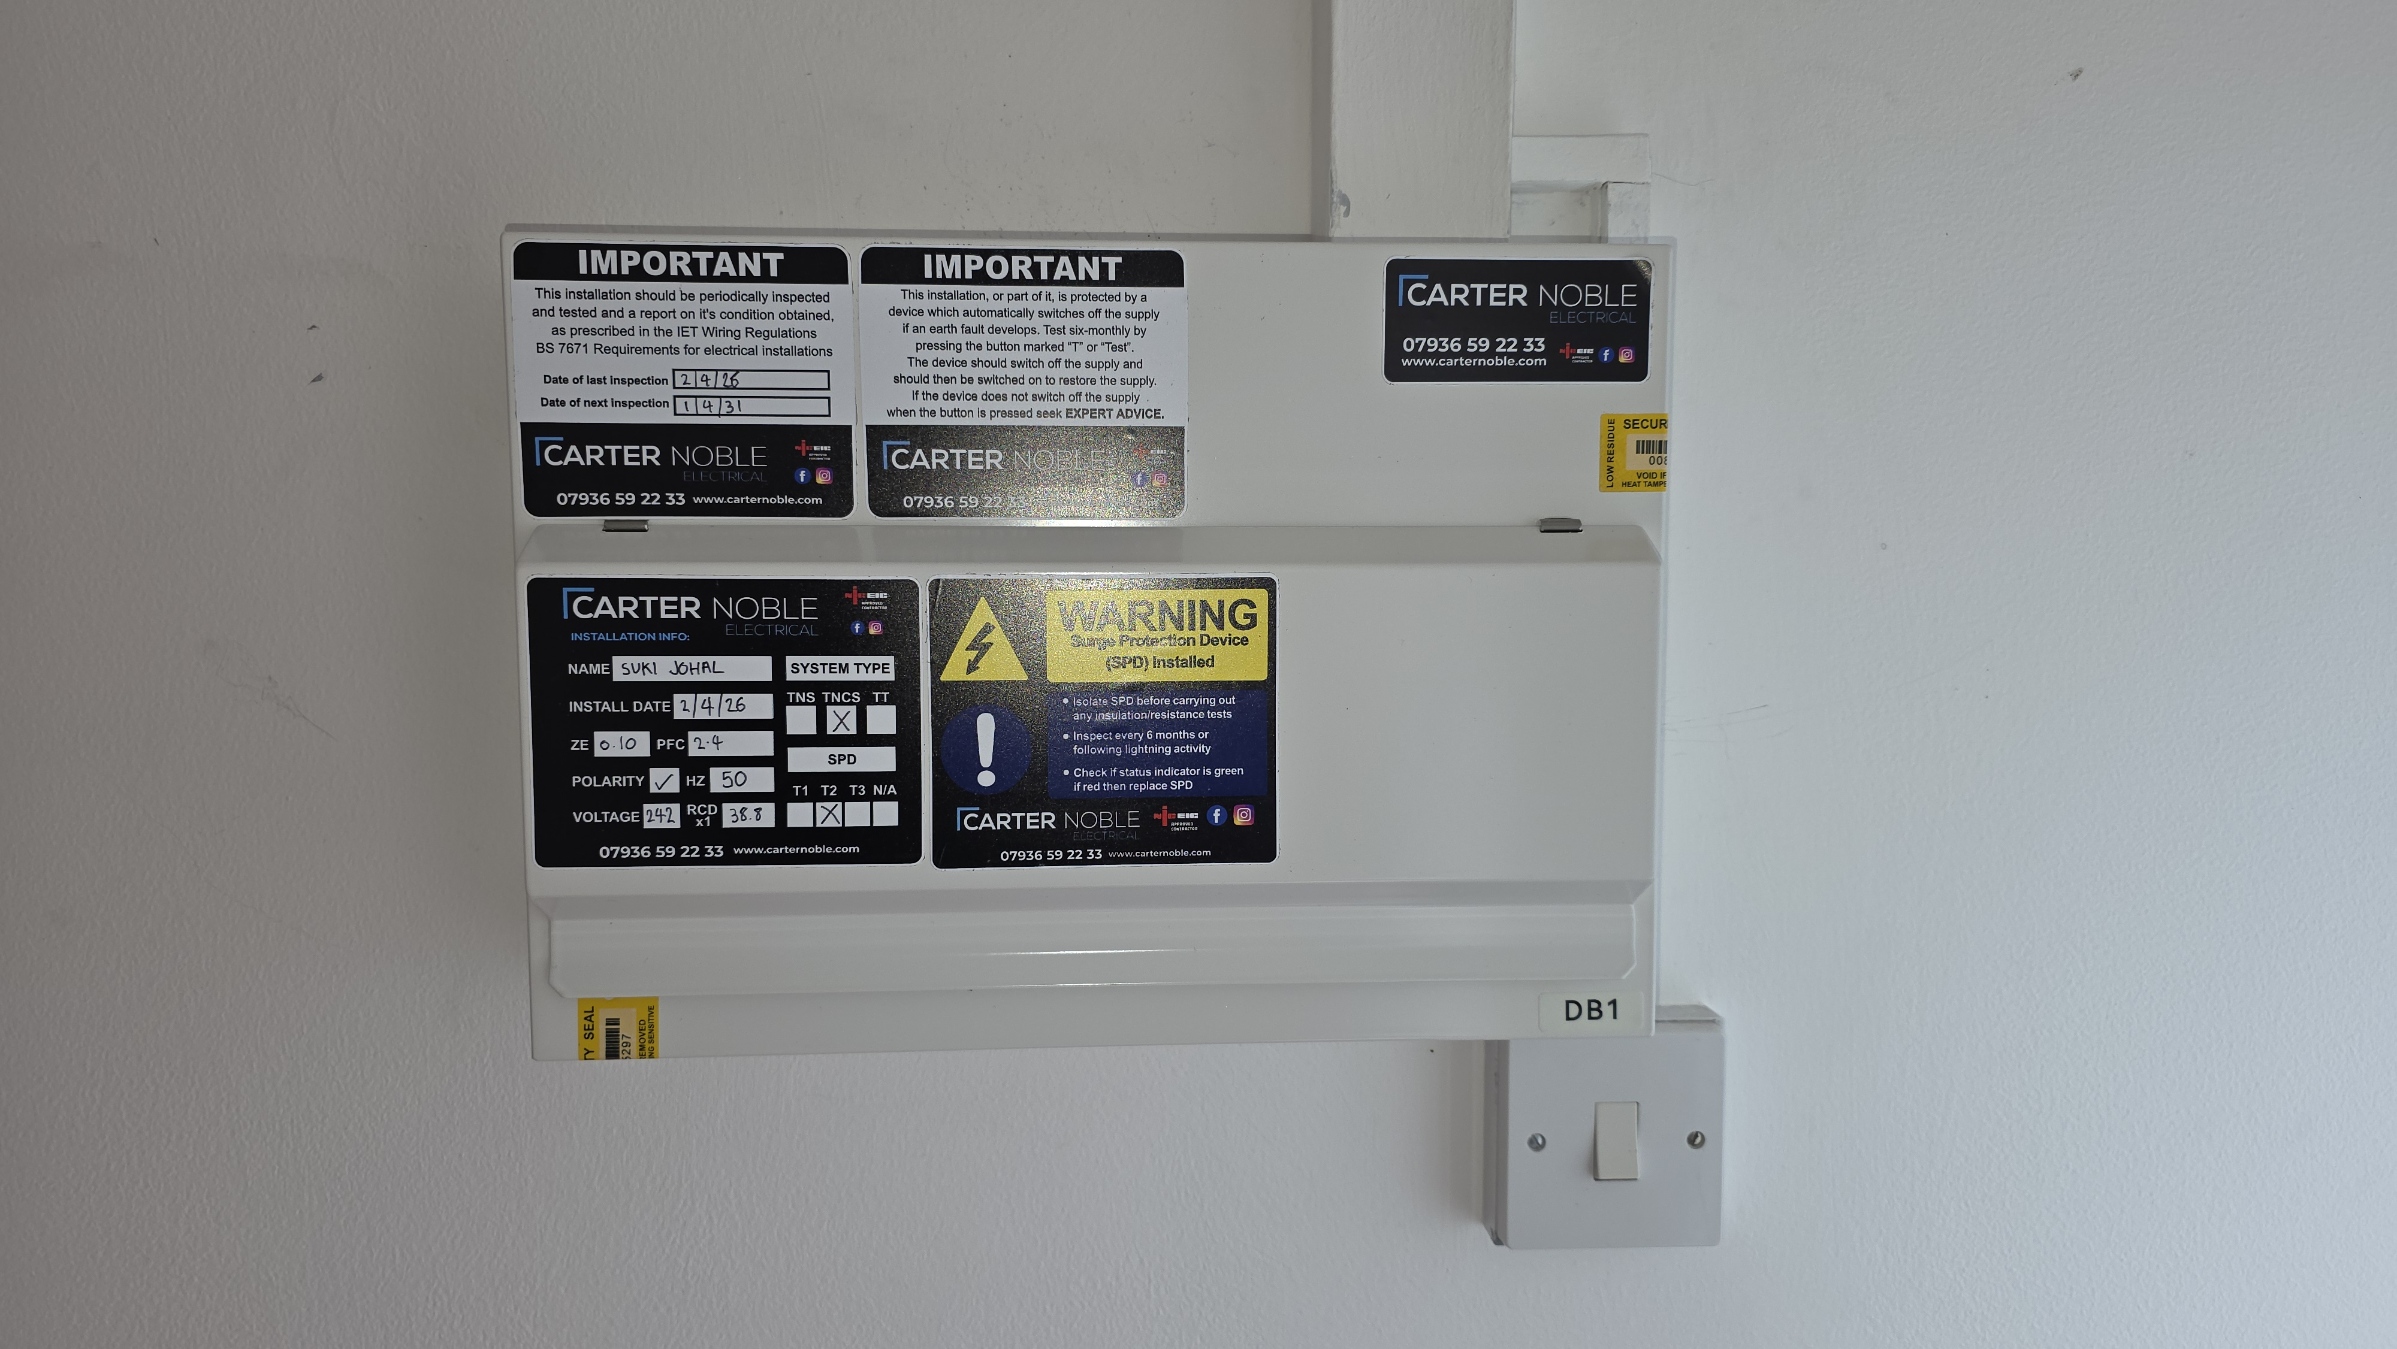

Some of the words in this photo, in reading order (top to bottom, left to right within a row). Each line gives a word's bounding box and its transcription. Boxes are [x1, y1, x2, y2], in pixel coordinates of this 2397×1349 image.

[578, 249, 784, 277] IMPORTANT
[924, 254, 1122, 280] IMPORTANT
[534, 287, 561, 299] This
[565, 287, 631, 300] installation
[635, 289, 675, 301] should
[679, 289, 695, 301] be
[699, 290, 768, 305] periodically
[772, 290, 829, 305] inspected
[900, 288, 924, 300] This
[927, 289, 989, 302] installation,
[992, 292, 1004, 301] or
[1007, 291, 1028, 303] part
[1031, 290, 1043, 301] of
[1045, 290, 1054, 303] it,
[1058, 291, 1067, 302] is
[1070, 291, 1121, 304] protected
[1124, 291, 1137, 304] by
[1140, 294, 1147, 302] a
[1407, 282, 1528, 306] CARTER
[1539, 283, 1637, 307] NOBLE
[888, 306, 924, 316] device
[927, 306, 959, 317] which
[962, 307, 1034, 321] automatically
[1037, 307, 1085, 318] switches
[1087, 308, 1102, 318] off
[1104, 308, 1121, 319] the
[1124, 308, 1160, 321] supply
[1549, 311, 1636, 324] ELECTRICAL
[551, 326, 566, 335] as
[570, 325, 635, 338] prescribed
[638, 325, 650, 336] in
[653, 325, 673, 337] the
[677, 325, 698, 337] IET
[701, 326, 741, 340] Wiring
[745, 326, 817, 341] Regulations
[902, 323, 909, 333] if
[912, 325, 926, 333] an
[929, 323, 957, 334] earth
[960, 323, 984, 334] fault
[987, 323, 1040, 337] develops.
[1042, 324, 1066, 335] Test
[1069, 324, 1130, 338] six-monthly
[1133, 325, 1146, 338] by
[536, 342, 554, 353] BS
[558, 342, 587, 354] 7671
[593, 342, 680, 357] Requirements
[683, 343, 700, 355] for
[703, 344, 758, 356] electrical
[762, 345, 833, 356] installations
[1402, 337, 1461, 352] 07936
[1466, 337, 1489, 352] 59
[1495, 337, 1518, 352] 22
[1522, 337, 1545, 352] 33
[1401, 355, 1546, 366] www.carternoble.com
[543, 374, 569, 384] Date
[572, 374, 584, 384] of
[586, 374, 607, 385] last
[609, 375, 668, 387] inspection
[540, 397, 566, 407] Date
[569, 397, 581, 407] of
[583, 398, 608, 407] next
[610, 397, 669, 409] inspection
[1607, 419, 1615, 462] RESIDUE
[544, 444, 661, 466] CARTER
[671, 445, 767, 467] NOBLE
[556, 492, 610, 505] 07936
[614, 492, 635, 505] 59
[640, 492, 661, 505] 22
[665, 492, 685, 505] 33
[692, 494, 822, 504] www.carternoble.com
[572, 595, 701, 618] CARTER
[713, 596, 818, 619] NOBLE
[1058, 599, 1258, 631] WARNING
[571, 632, 656, 641] INSTALLATION
[658, 632, 690, 641] INFO:
[1119, 634, 1195, 647] Protection
[1200, 634, 1249, 646] Device
[568, 663, 610, 674] NAME
[622, 662, 657, 676] SUKI
[670, 661, 724, 675] JOHAL
[790, 662, 849, 674] SYSTEM
[853, 662, 890, 674] TYPE
[1153, 656, 1214, 668] Installed
[786, 691, 815, 702] TNS
[821, 691, 860, 702] TNCS
[872, 691, 889, 702] TT
[569, 700, 629, 712] INSTALL
[633, 700, 671, 712] DATE
[1073, 731, 1112, 742] Inspect
[1114, 732, 1144, 742] every
[1146, 730, 1153, 739] 6
[1155, 729, 1195, 739] months
[1197, 731, 1209, 739] or
[570, 739, 589, 750] ZE
[656, 738, 685, 750] PFC
[1072, 744, 1122, 756] following
[1125, 744, 1171, 755] lightning
[1173, 743, 1211, 755] activity
[827, 753, 856, 765] SPD
[1073, 767, 1107, 777] Check
[1110, 767, 1117, 776] if
[1119, 767, 1151, 776] status
[1154, 766, 1200, 776] indicator
[1202, 766, 1211, 775] is
[1214, 767, 1243, 777] green
[572, 775, 644, 787] POLARITY
[686, 775, 705, 786] HZ
[722, 771, 747, 788] 50
[1073, 781, 1081, 791] if
[1083, 781, 1100, 791] red
[1102, 781, 1126, 791] then
[1129, 780, 1167, 792] replace
[1170, 780, 1193, 790] SPD
[792, 784, 807, 796] T1
[820, 784, 837, 796] T2
[848, 784, 865, 795] T3
[873, 784, 897, 795] N/A
[572, 811, 640, 822] VOLTAGE
[687, 804, 717, 817] RCD
[695, 815, 710, 826] x1
[963, 811, 1056, 830] CARTER
[1064, 810, 1140, 828] NOBLE
[599, 845, 651, 858] 07936
[655, 845, 676, 858] 59
[680, 845, 700, 857] 22
[704, 845, 724, 857] 33
[732, 844, 860, 854] www.carternoble.com
[1566, 999, 1617, 1021] DB1
[584, 1006, 594, 1040] SEAL
